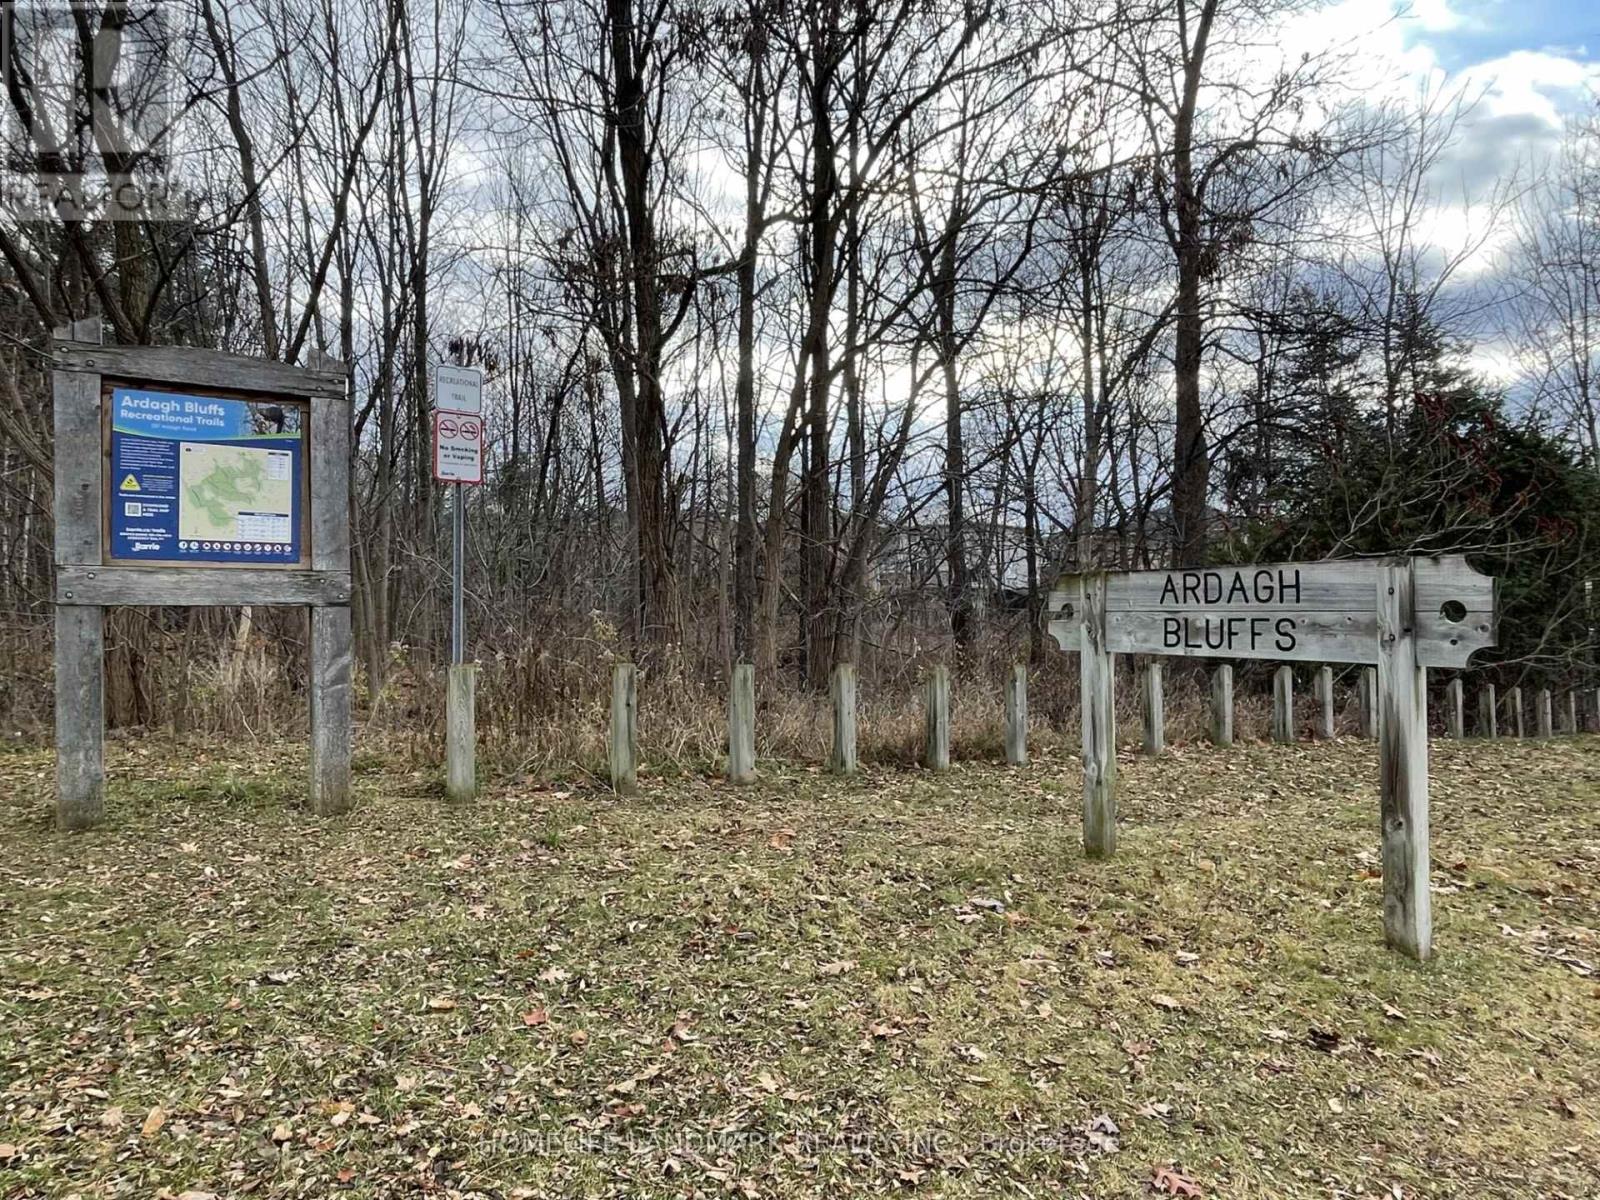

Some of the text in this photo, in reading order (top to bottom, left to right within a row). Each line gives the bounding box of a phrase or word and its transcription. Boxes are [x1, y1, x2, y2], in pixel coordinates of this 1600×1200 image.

[121, 395, 225, 416] Ardagh Bluffs
[120, 409, 193, 424] Recreational
[196, 416, 225, 427] Trails
[450, 445, 478, 455] Smoking
[452, 453, 475, 462] Vaping
[1159, 569, 1301, 605] ARDAGH
[1163, 617, 1297, 652] BLUFFS
